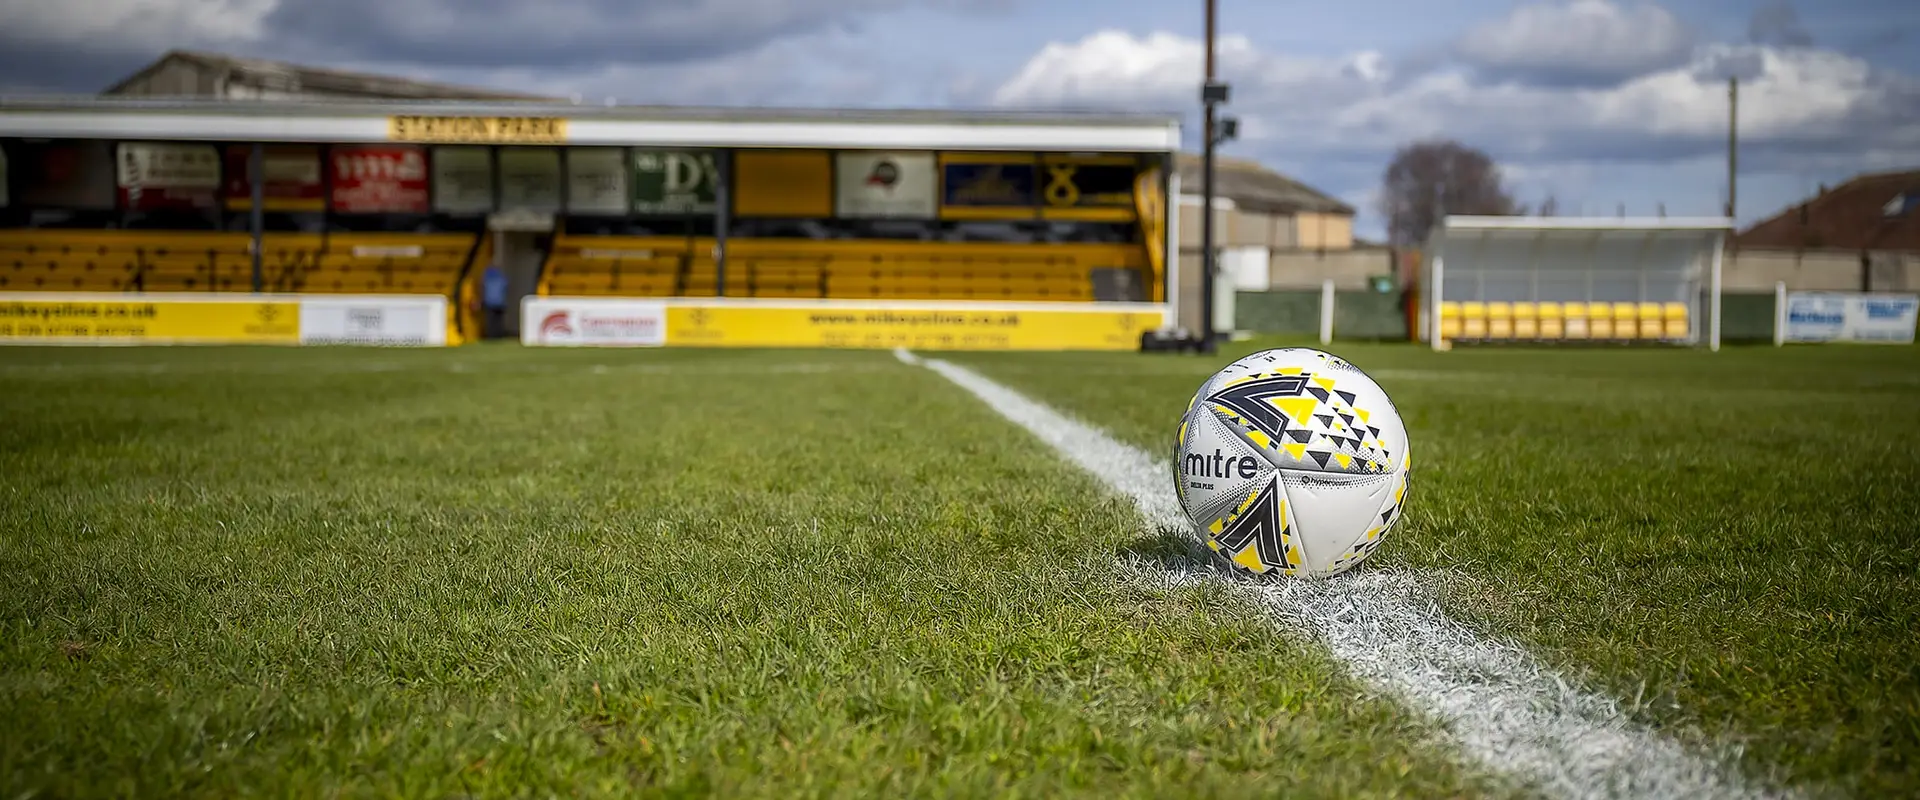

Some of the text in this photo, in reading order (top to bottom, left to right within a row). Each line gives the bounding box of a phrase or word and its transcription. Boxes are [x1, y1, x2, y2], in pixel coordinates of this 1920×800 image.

[395, 115, 563, 139] STATION PARK
[1186, 449, 1258, 479] mitre
[1191, 481, 1202, 489] DELTA
